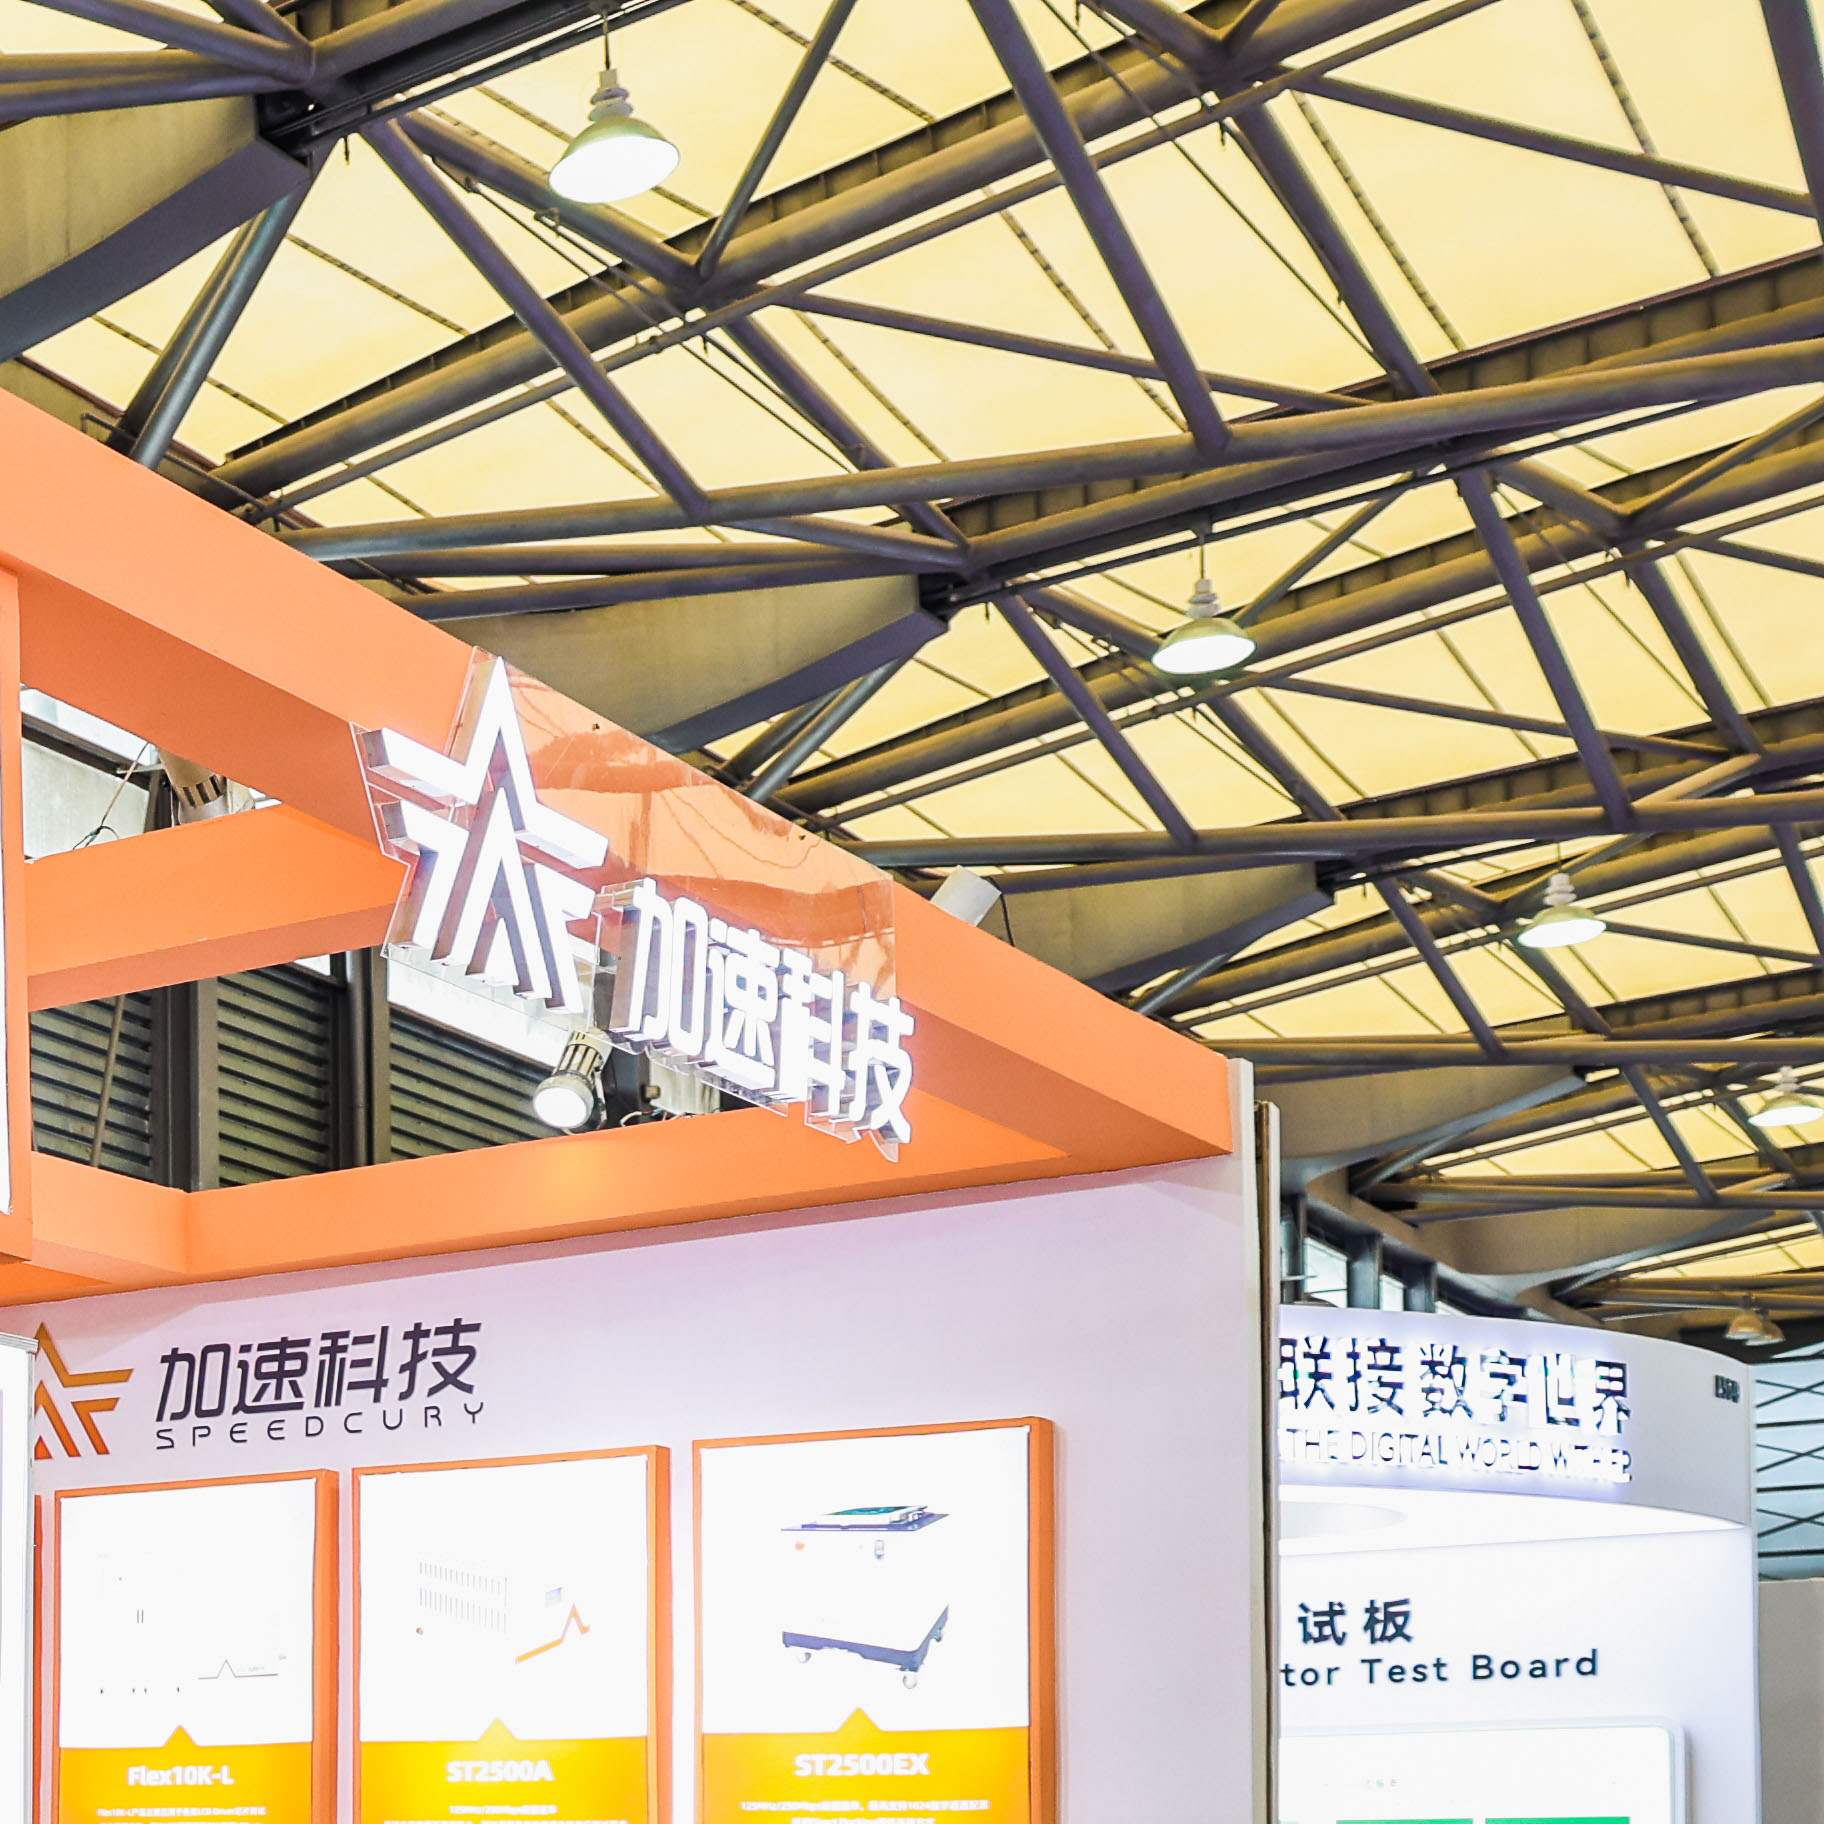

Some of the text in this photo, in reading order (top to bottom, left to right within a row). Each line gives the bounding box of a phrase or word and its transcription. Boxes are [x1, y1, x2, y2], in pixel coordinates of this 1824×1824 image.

[609, 877, 915, 1143] 加速科技
[155, 1317, 482, 1424] 加速科技
[1278, 1336, 1631, 1435] 联接数字世界
[155, 1400, 484, 1450] SPEEDCURY
[1351, 1431, 1448, 1465] DIGITAL
[1297, 1597, 1413, 1646] 试板
[1360, 1657, 1448, 1685] Test
[1472, 1648, 1598, 1681] Board
[127, 1765, 235, 1786] Flex10K-L
[446, 1760, 555, 1782] ST2500A
[794, 1752, 930, 1777] ST2500EX
